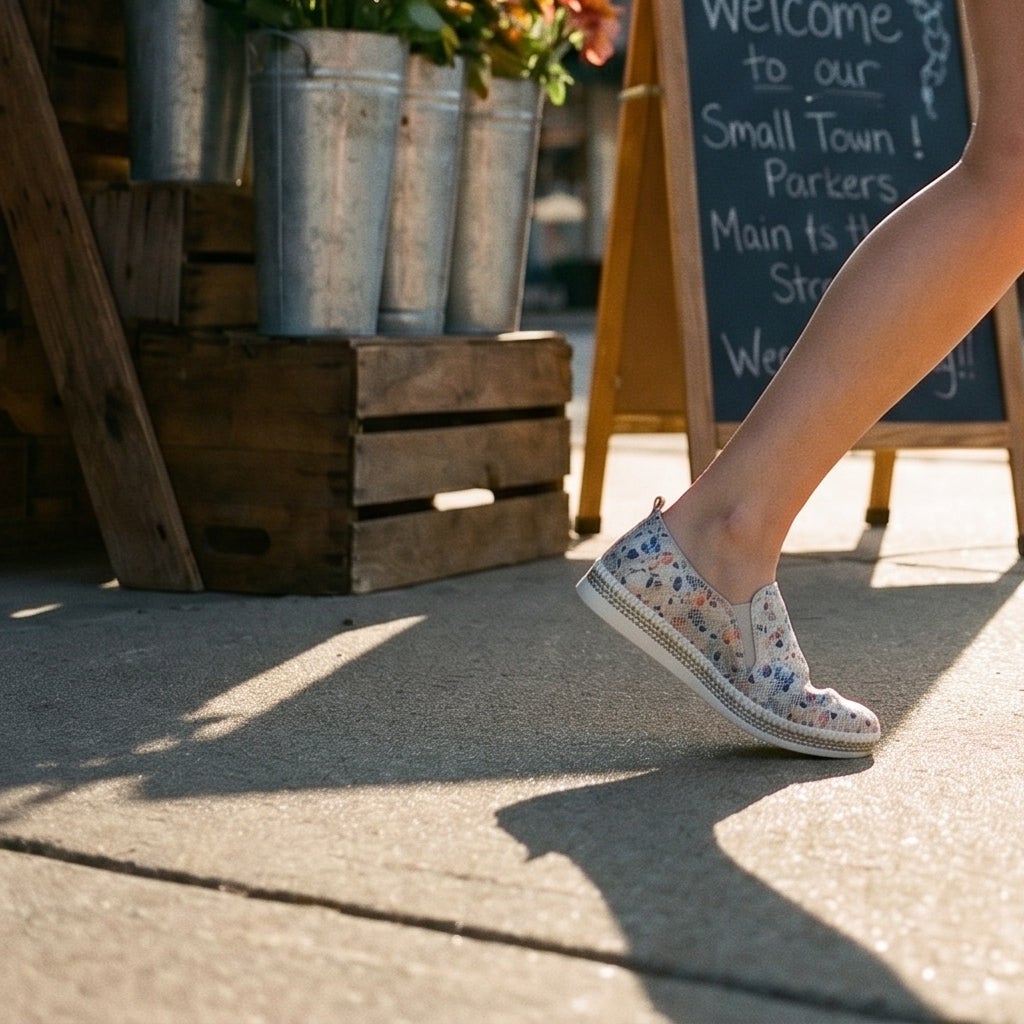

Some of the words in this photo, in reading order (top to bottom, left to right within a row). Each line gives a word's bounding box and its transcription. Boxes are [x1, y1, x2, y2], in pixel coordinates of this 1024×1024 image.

[743, 43, 787, 82] to
[814, 57, 881, 88] our
[701, 102, 796, 152] Small
[804, 110, 896, 155] Town
[764, 157, 899, 205] Parkers
[710, 207, 793, 252] Main
